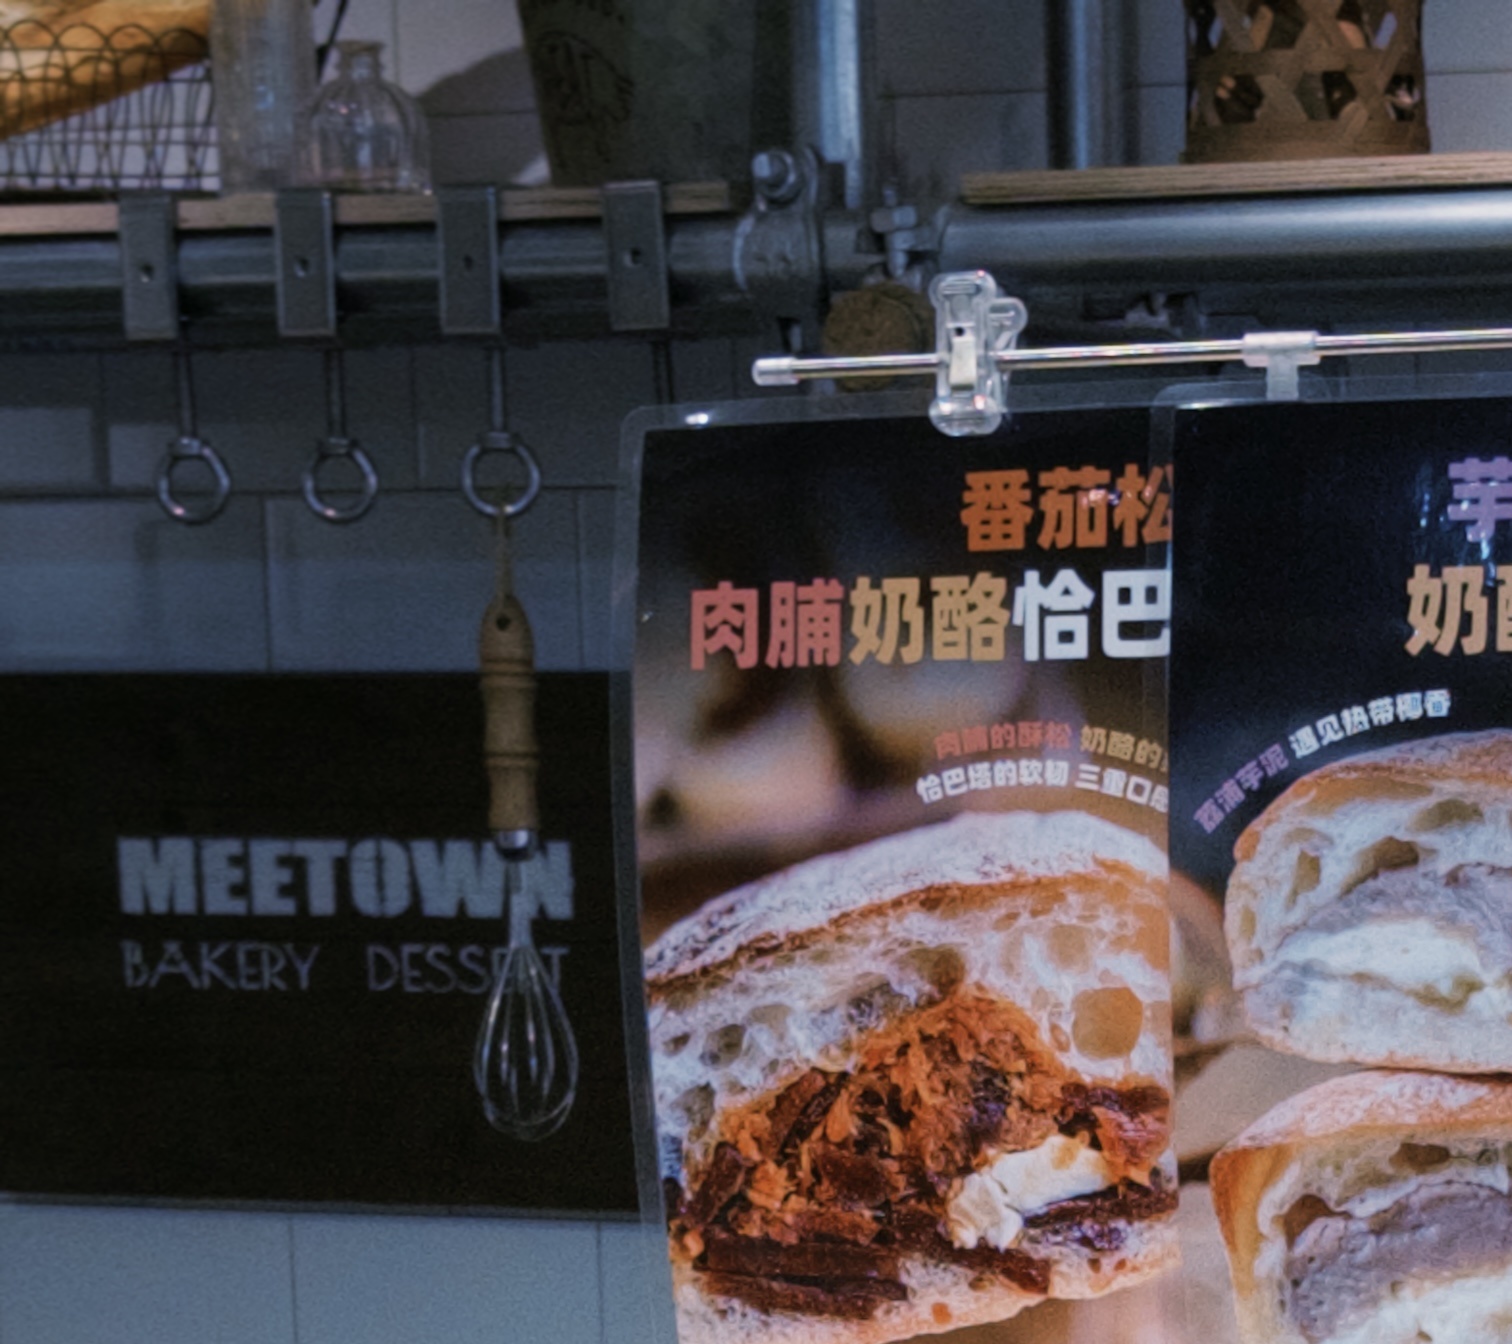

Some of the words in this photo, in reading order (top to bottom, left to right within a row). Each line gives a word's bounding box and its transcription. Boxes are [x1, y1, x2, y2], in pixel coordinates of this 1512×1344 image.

[690, 568, 1171, 671] 肉脯奶酪恰巴
[116, 836, 575, 920] MEETOWN
[120, 941, 319, 991] BAKERY
